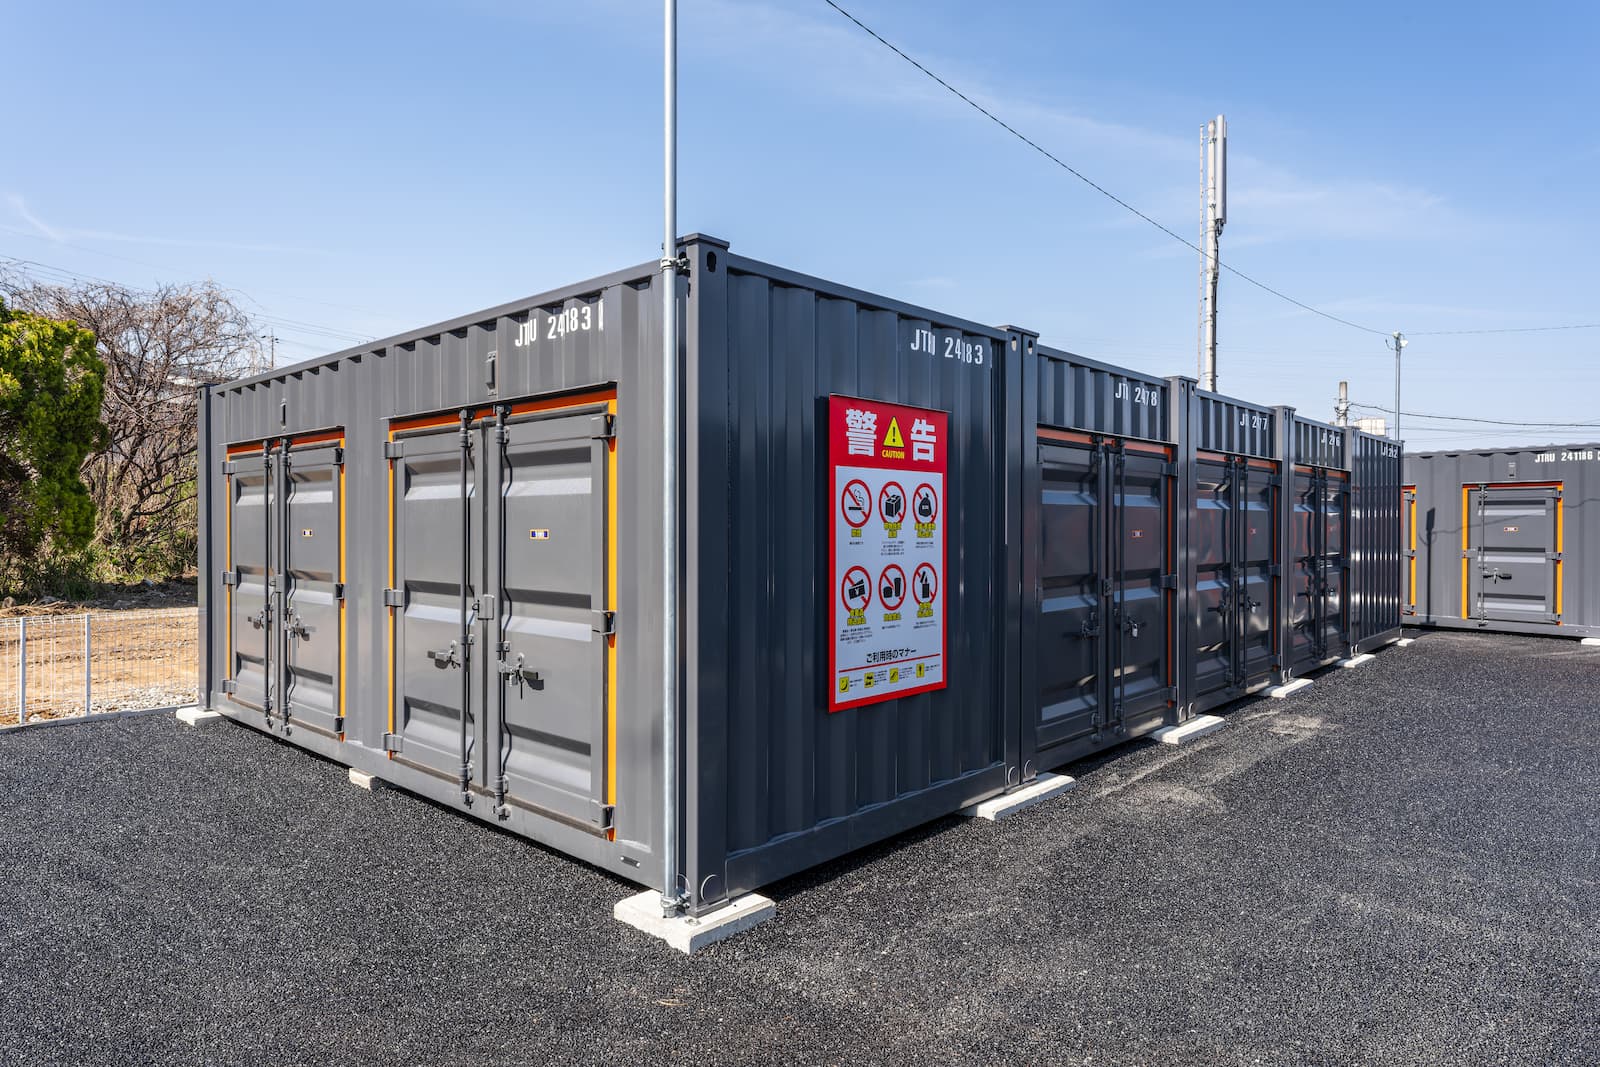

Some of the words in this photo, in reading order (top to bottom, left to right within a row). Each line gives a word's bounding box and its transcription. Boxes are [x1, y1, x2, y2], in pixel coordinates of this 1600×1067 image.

[881, 449, 905, 459] CAUTION
[866, 647, 917, 663] ご利用時のマナー
